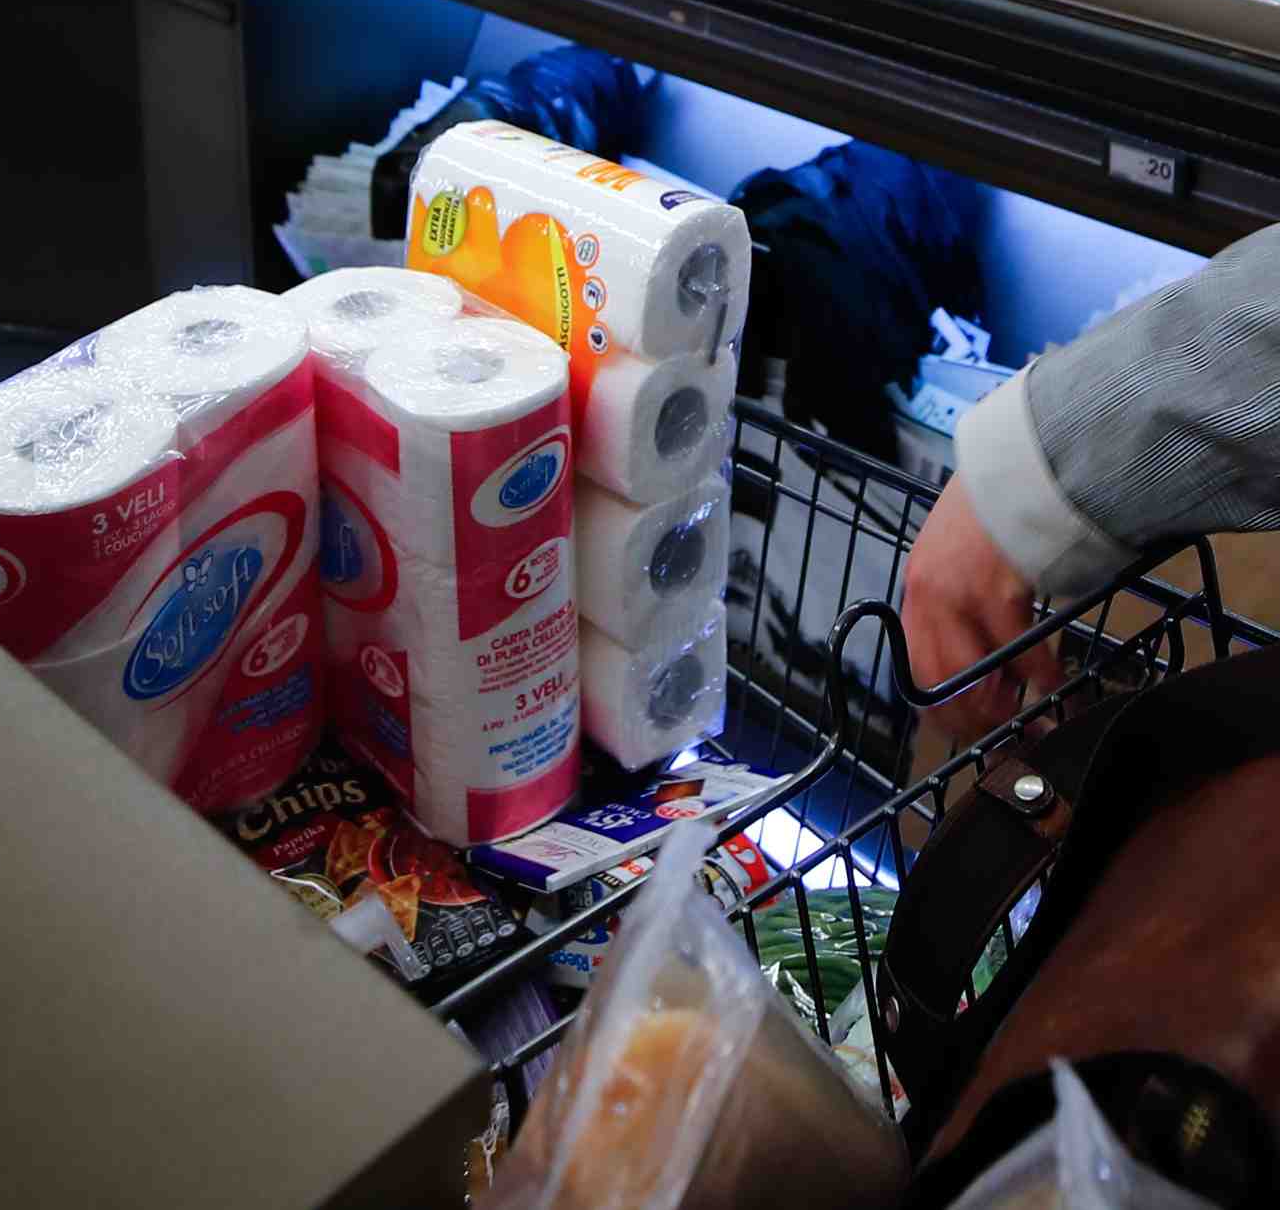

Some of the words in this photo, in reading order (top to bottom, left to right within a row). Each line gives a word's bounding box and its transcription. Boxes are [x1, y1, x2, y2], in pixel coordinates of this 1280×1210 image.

[92, 512, 109, 535] 3
[116, 482, 165, 520] VELI
[513, 562, 532, 594] 6
[515, 693, 527, 710] 3
[532, 672, 563, 700] VELI
[236, 779, 368, 841] Chips
[271, 823, 327, 857] Paprika
